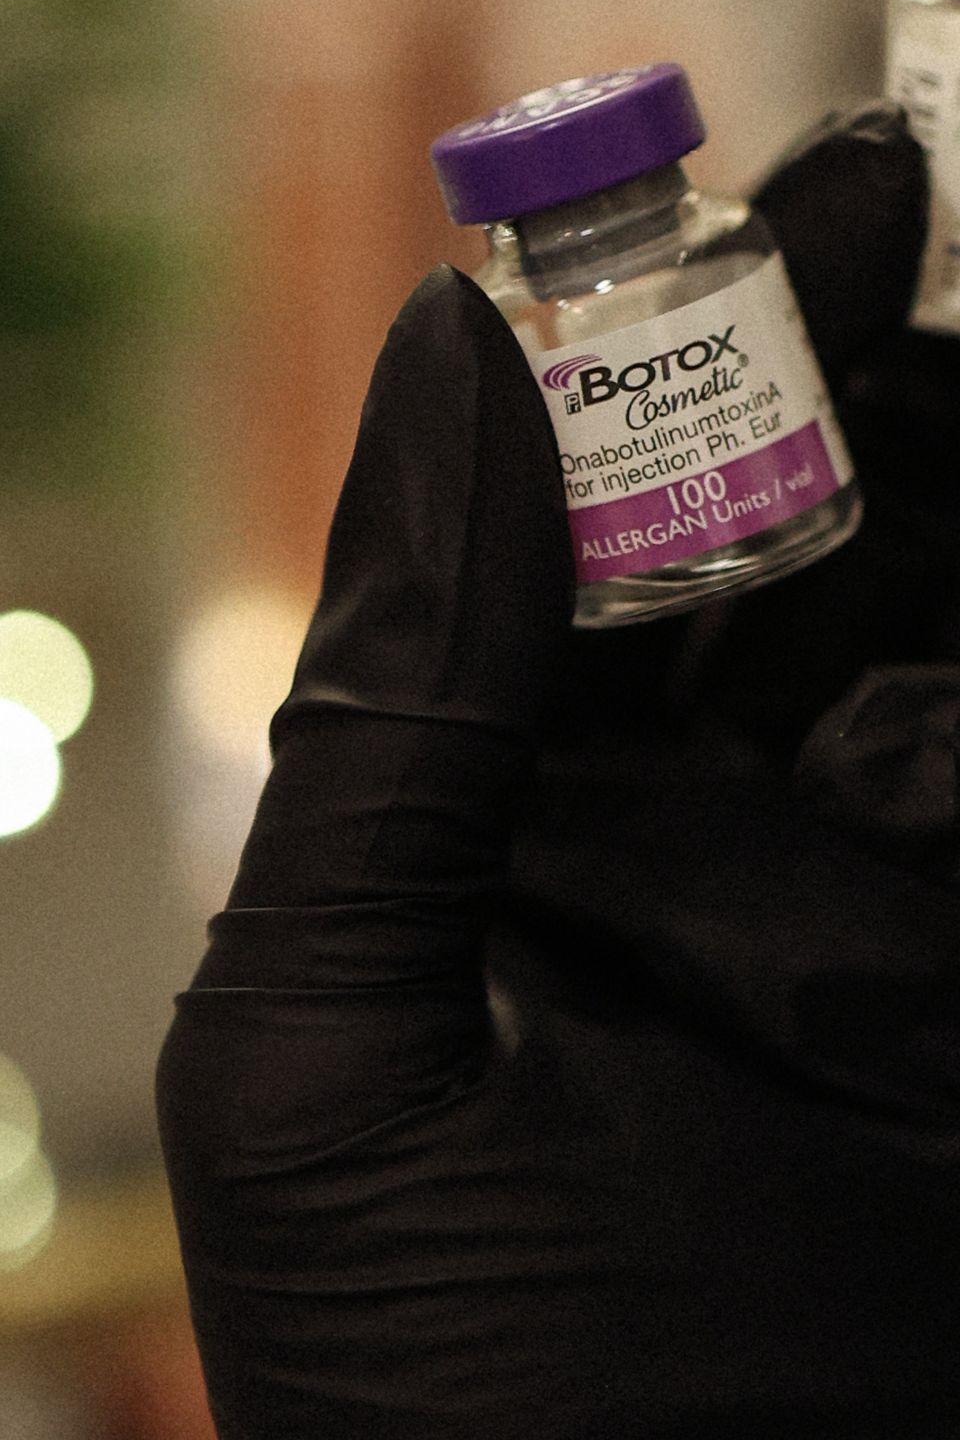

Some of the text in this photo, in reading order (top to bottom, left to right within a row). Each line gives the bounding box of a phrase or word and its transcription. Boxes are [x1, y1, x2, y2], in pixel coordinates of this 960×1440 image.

[561, 381, 783, 475] OnabotulinumtoxinA
[625, 365, 744, 431] Cosmetic
[565, 411, 782, 500] for injection Ph. Eur
[581, 509, 708, 561] ALLERGAN
[712, 490, 772, 523] Units
[666, 470, 727, 515] 100
